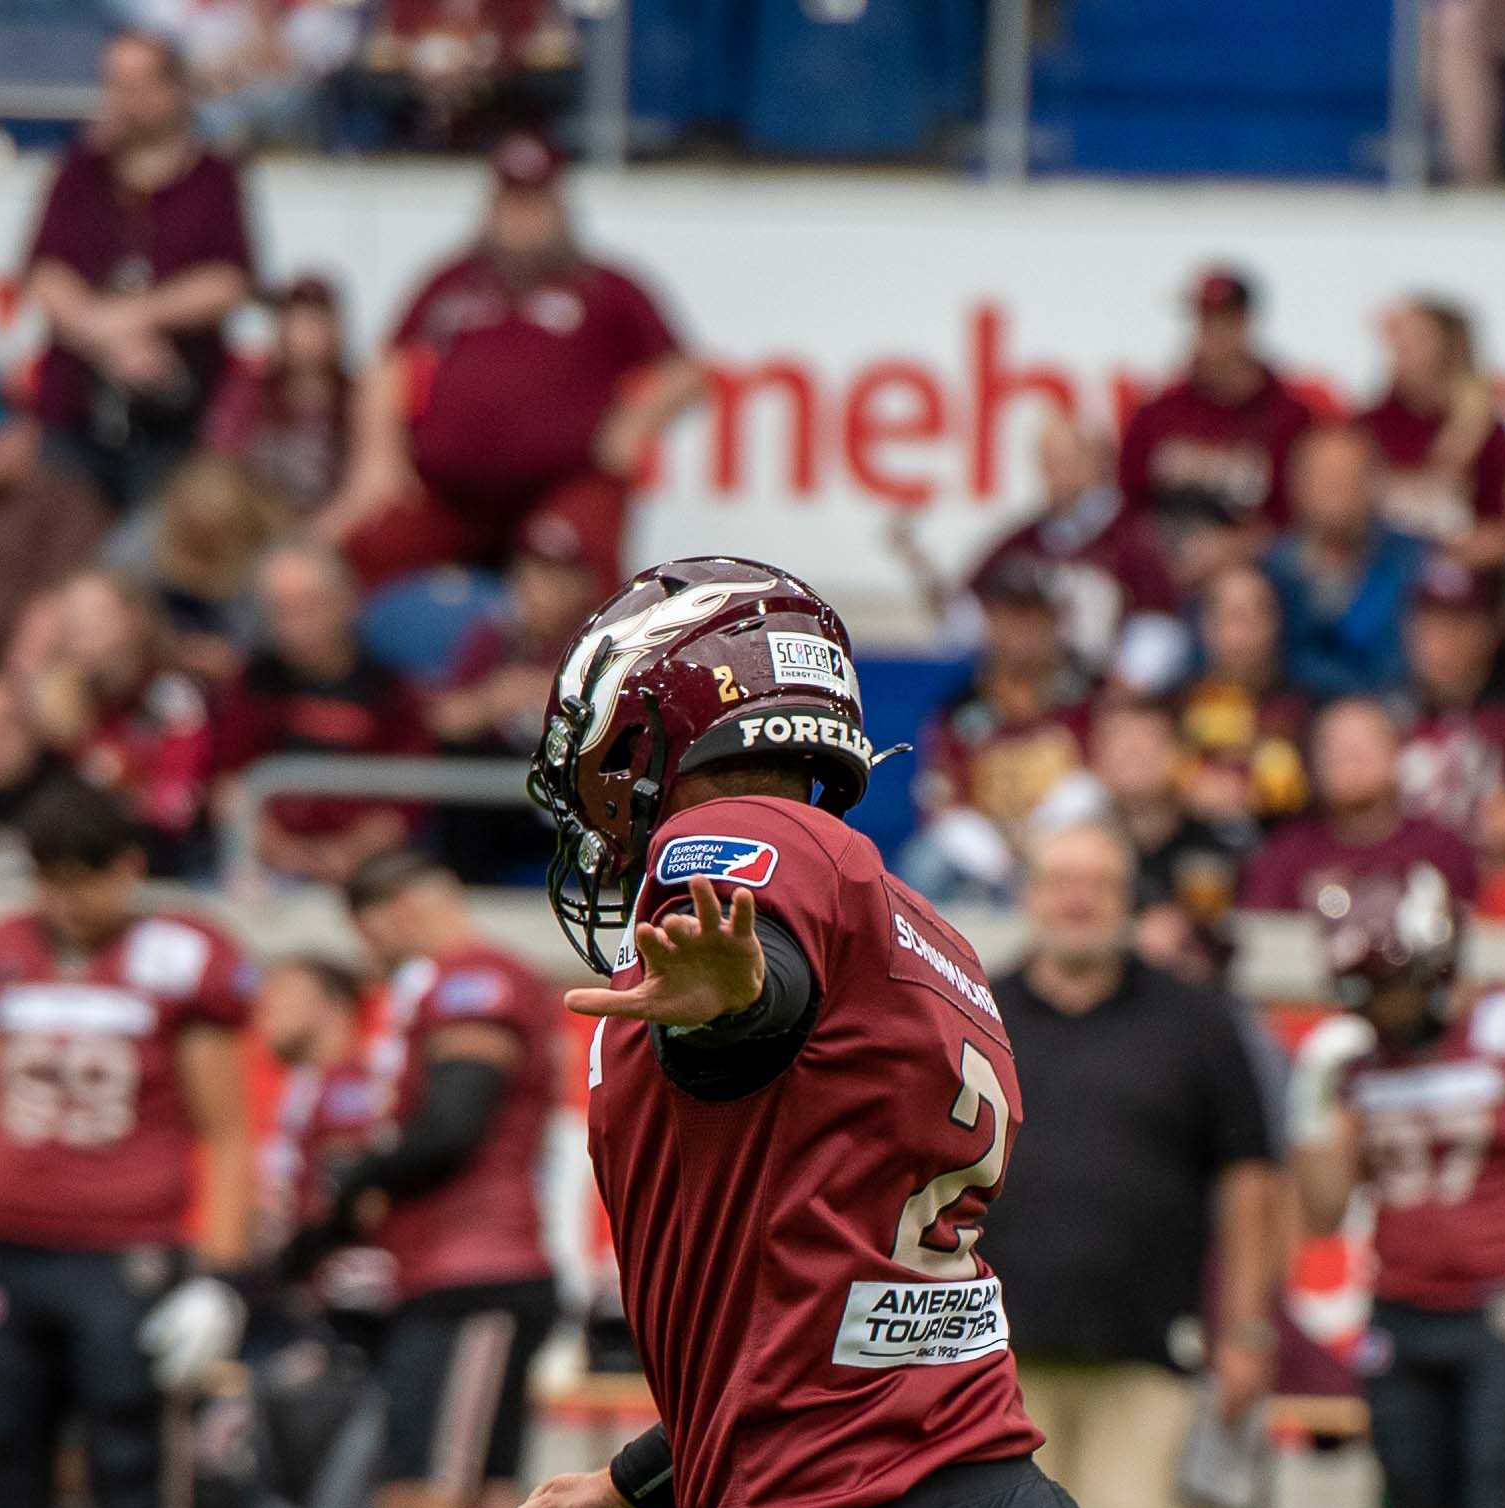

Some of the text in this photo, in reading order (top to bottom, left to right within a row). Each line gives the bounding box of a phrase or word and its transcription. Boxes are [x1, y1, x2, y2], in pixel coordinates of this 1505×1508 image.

[712, 665, 740, 703] 2
[668, 853, 704, 863] LEAGUE
[672, 844, 723, 855] EUROPEAN
[667, 862, 713, 875] FOOTBALL
[892, 1037, 1011, 1280] 2
[865, 1310, 998, 1343] TOURISTER
